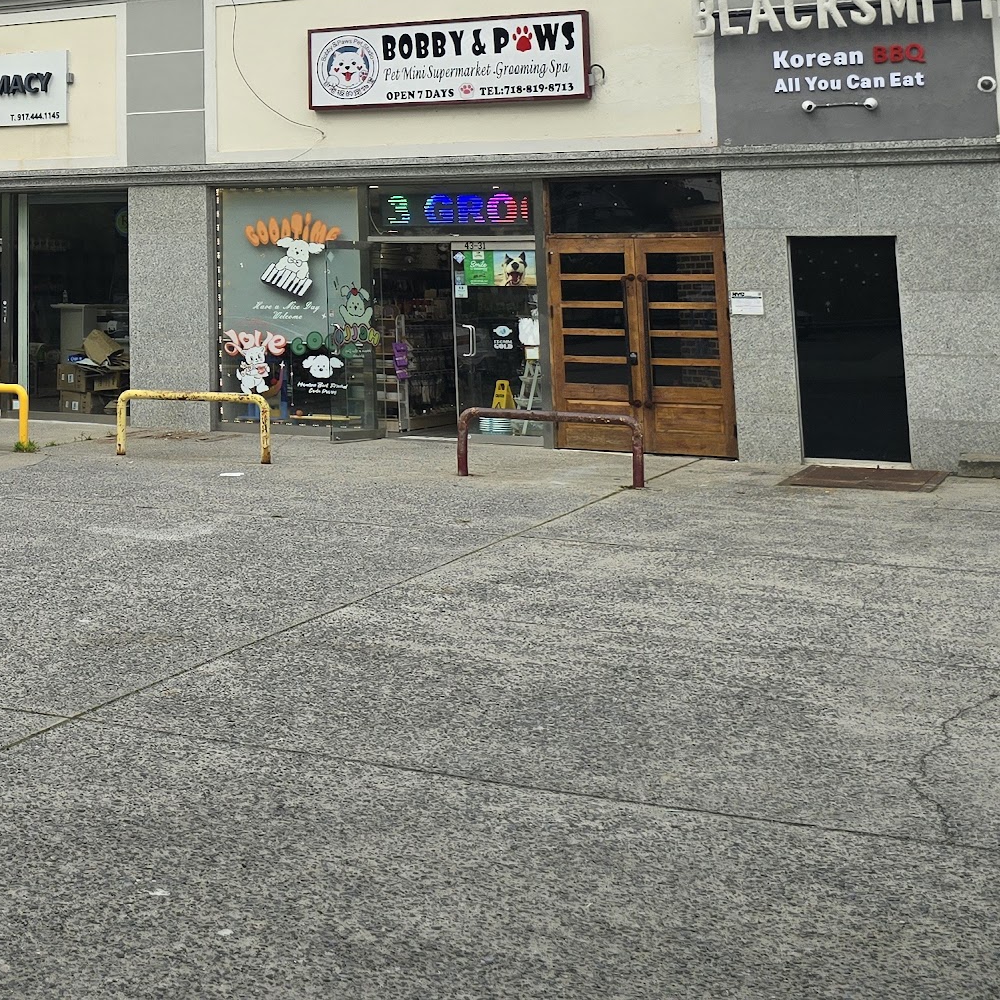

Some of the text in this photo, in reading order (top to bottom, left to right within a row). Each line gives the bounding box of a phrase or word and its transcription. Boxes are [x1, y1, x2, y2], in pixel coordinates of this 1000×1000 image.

[381, 29, 465, 61] BOBBY
[471, 28, 486, 57] &
[773, 43, 926, 69] Korean BBQ
[382, 67, 400, 82] Pet
[402, 65, 426, 81] Mini
[427, 61, 491, 83] Supermarket
[549, 59, 571, 78] Spa
[774, 71, 925, 93] All You Can Eat
[386, 90, 416, 101] OPEN
[417, 90, 423, 99] 7
[425, 88, 455, 99] DAYS
[17, 112, 60, 121] 917.444.1145
[464, 241, 486, 250] 43-31
[252, 301, 273, 310] Have
[281, 301, 301, 310] Nice
[302, 301, 321, 313] Day
[272, 311, 303, 320] Welcome
